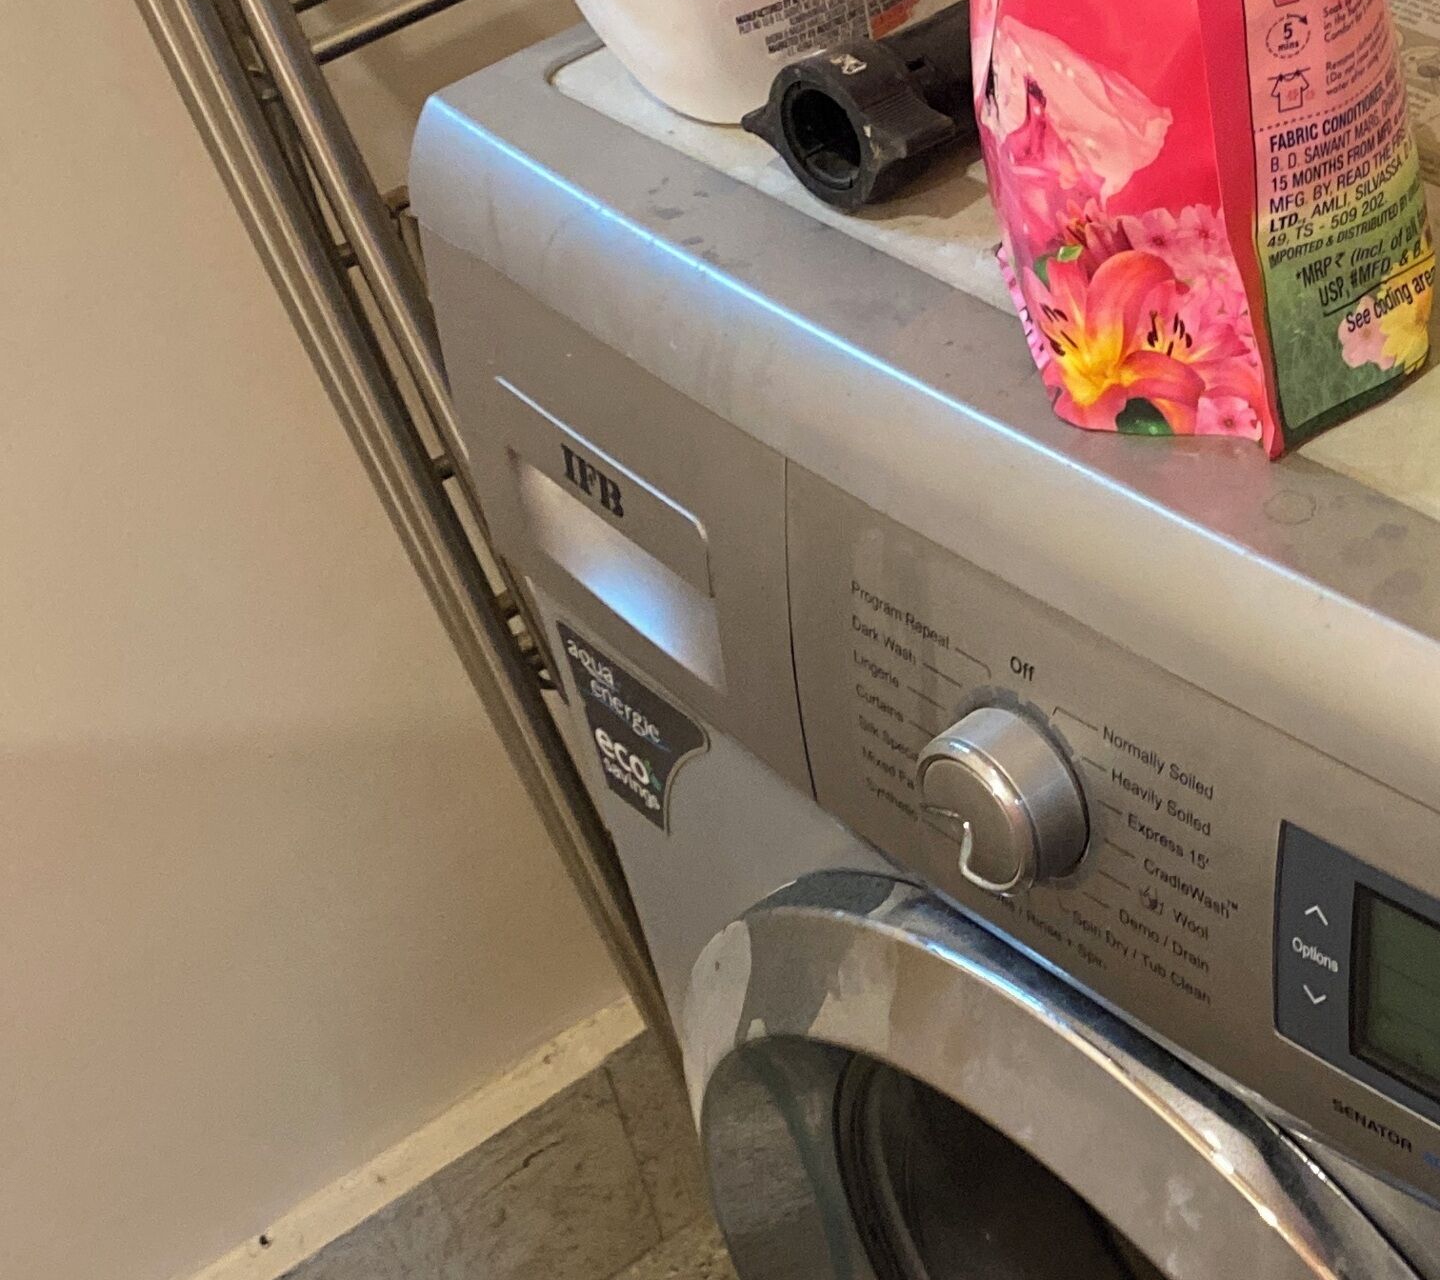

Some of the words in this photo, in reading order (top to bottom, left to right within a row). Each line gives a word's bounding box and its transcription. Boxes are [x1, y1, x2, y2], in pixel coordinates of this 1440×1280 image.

[1277, 40, 1300, 54] mins
[1282, 22, 1294, 41] 5
[1270, 122, 1319, 153] FABRIC
[1304, 129, 1352, 164] SAWANT
[1272, 174, 1288, 193] 15
[1292, 154, 1345, 189] MONTHS
[1347, 137, 1376, 166] FROM
[1336, 159, 1371, 191] READ
[1373, 147, 1392, 169] THE
[1355, 155, 1403, 202] SILVASSA
[1267, 237, 1323, 269] IMPORTED
[1325, 234, 1335, 248] &
[1336, 203, 1399, 244] DISTRIBUTED
[1296, 222, 1314, 241] TS
[1330, 206, 1358, 230] 509
[1350, 239, 1386, 267] (incl.
[1390, 226, 1404, 251] of
[1318, 275, 1350, 308] USP,
[1398, 249, 1409, 267] &
[1345, 308, 1372, 333] See
[1373, 280, 1413, 320] coding
[560, 442, 625, 519] IFB
[851, 579, 903, 622] Program
[905, 611, 950, 651] Repeat
[852, 614, 879, 640] Dark
[884, 636, 917, 666] Wash
[1009, 655, 1036, 682] Off
[594, 726, 650, 786] eco
[1103, 724, 1166, 776] Normally
[1168, 762, 1215, 801] Soiled
[1111, 767, 1163, 812] Heavily
[1166, 799, 1212, 837] Soiled
[1127, 812, 1184, 858] Express
[1173, 907, 1209, 941] Wool
[1104, 929, 1130, 957] Dry
[1140, 953, 1167, 979] Tub
[1169, 970, 1212, 1006] Clean
[1171, 940, 1210, 973] Drain
[1291, 935, 1339, 974] Options
[1331, 1097, 1414, 1154] SENATOR
